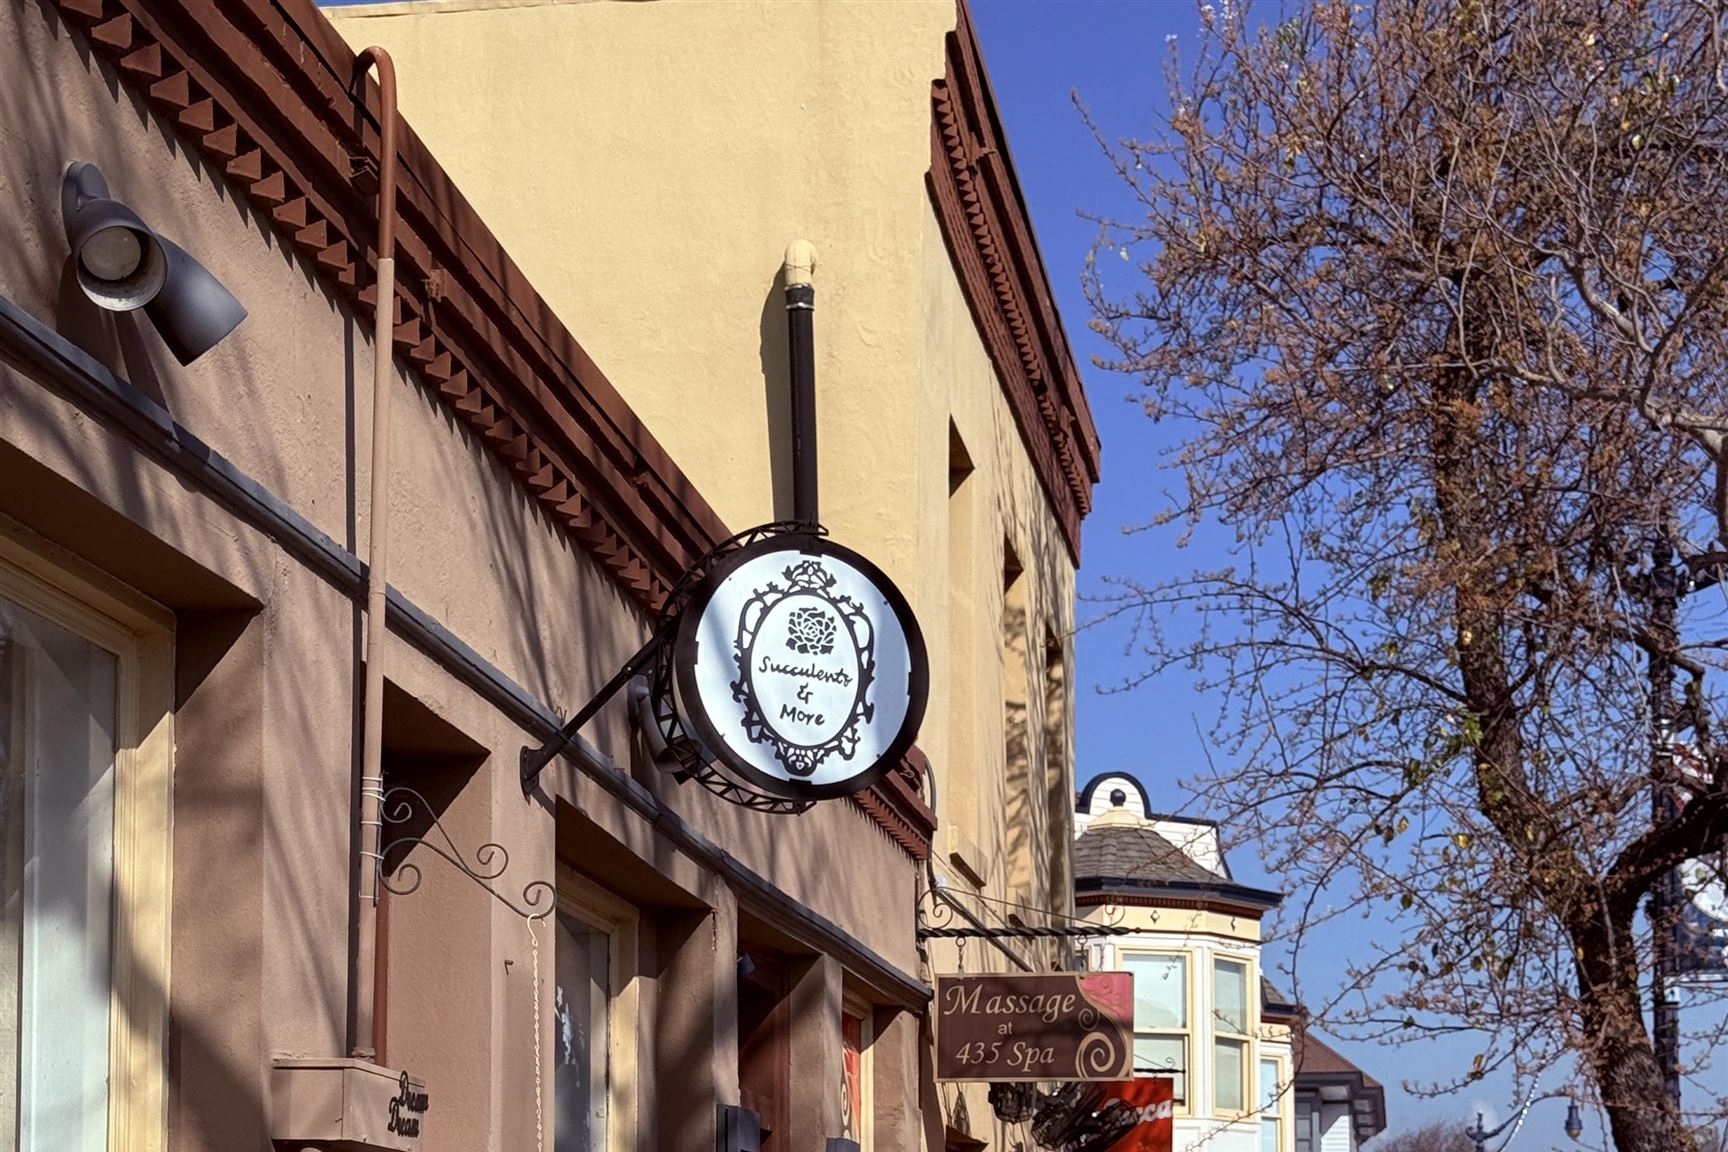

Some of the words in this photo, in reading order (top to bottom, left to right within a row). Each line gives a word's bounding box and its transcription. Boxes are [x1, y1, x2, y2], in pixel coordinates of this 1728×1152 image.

[758, 655, 853, 687] Succulents
[796, 682, 814, 704] &
[779, 703, 826, 726] More
[943, 983, 1076, 1023] Massage
[998, 1022, 1013, 1035] at
[956, 1042, 1003, 1065] 435
[1006, 1041, 1056, 1073] Spa
